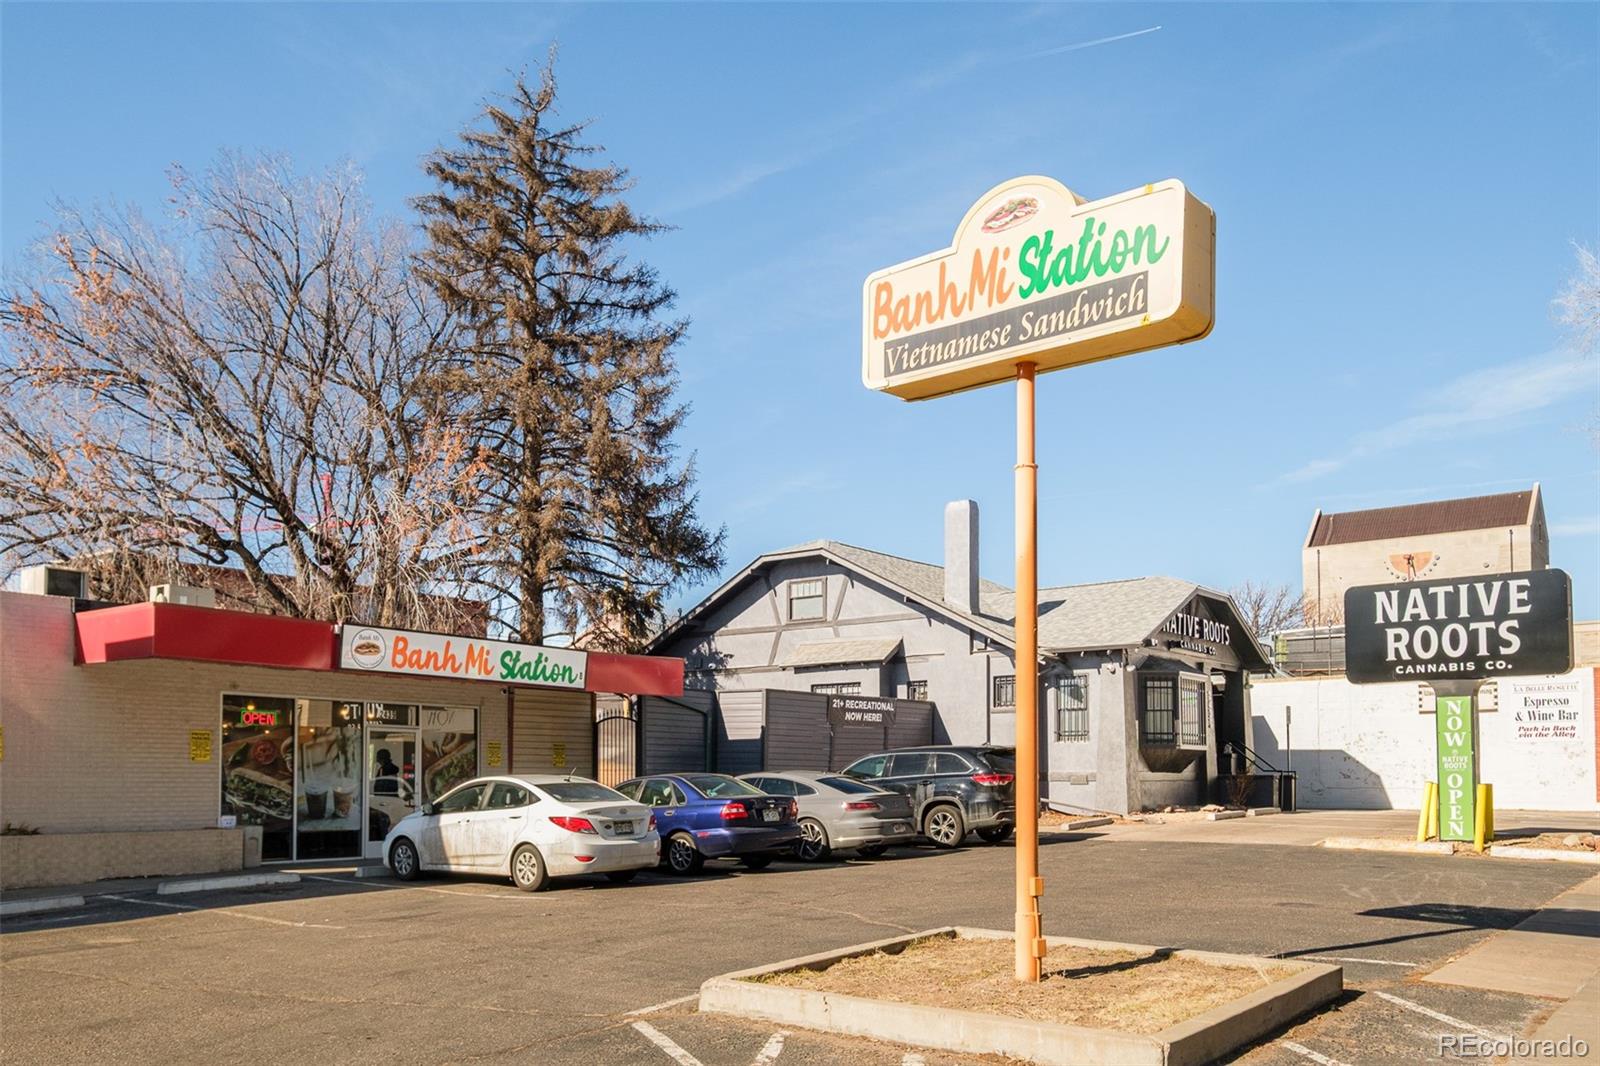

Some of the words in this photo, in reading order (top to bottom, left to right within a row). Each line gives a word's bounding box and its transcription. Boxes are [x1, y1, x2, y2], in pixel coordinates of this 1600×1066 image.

[873, 262, 968, 340] Banh
[969, 246, 1015, 309] Mi
[1018, 217, 1170, 300] Station
[885, 324, 1012, 374] Vietnamese
[1019, 274, 1146, 343] Sandwich
[1374, 578, 1533, 625] NATIVE
[1203, 619, 1230, 645] ROOTS
[1384, 618, 1522, 663] ROOTS
[391, 635, 462, 673] Banh
[464, 642, 495, 678] Mi
[499, 649, 578, 684] Station
[1395, 660, 1476, 675] CANNABIS
[1485, 660, 1513, 671] CO.
[845, 699, 895, 711] RECREATIONAL
[1514, 711, 1523, 722] &
[1527, 710, 1555, 721] Wine
[1558, 709, 1579, 720] Bar
[1524, 697, 1569, 709] Espresso
[243, 712, 275, 726] OPEN
[845, 712, 862, 721] NOW
[1444, 700, 1467, 747] NOW
[1552, 731, 1576, 739] Alley
[1446, 773, 1465, 837] OPEN
